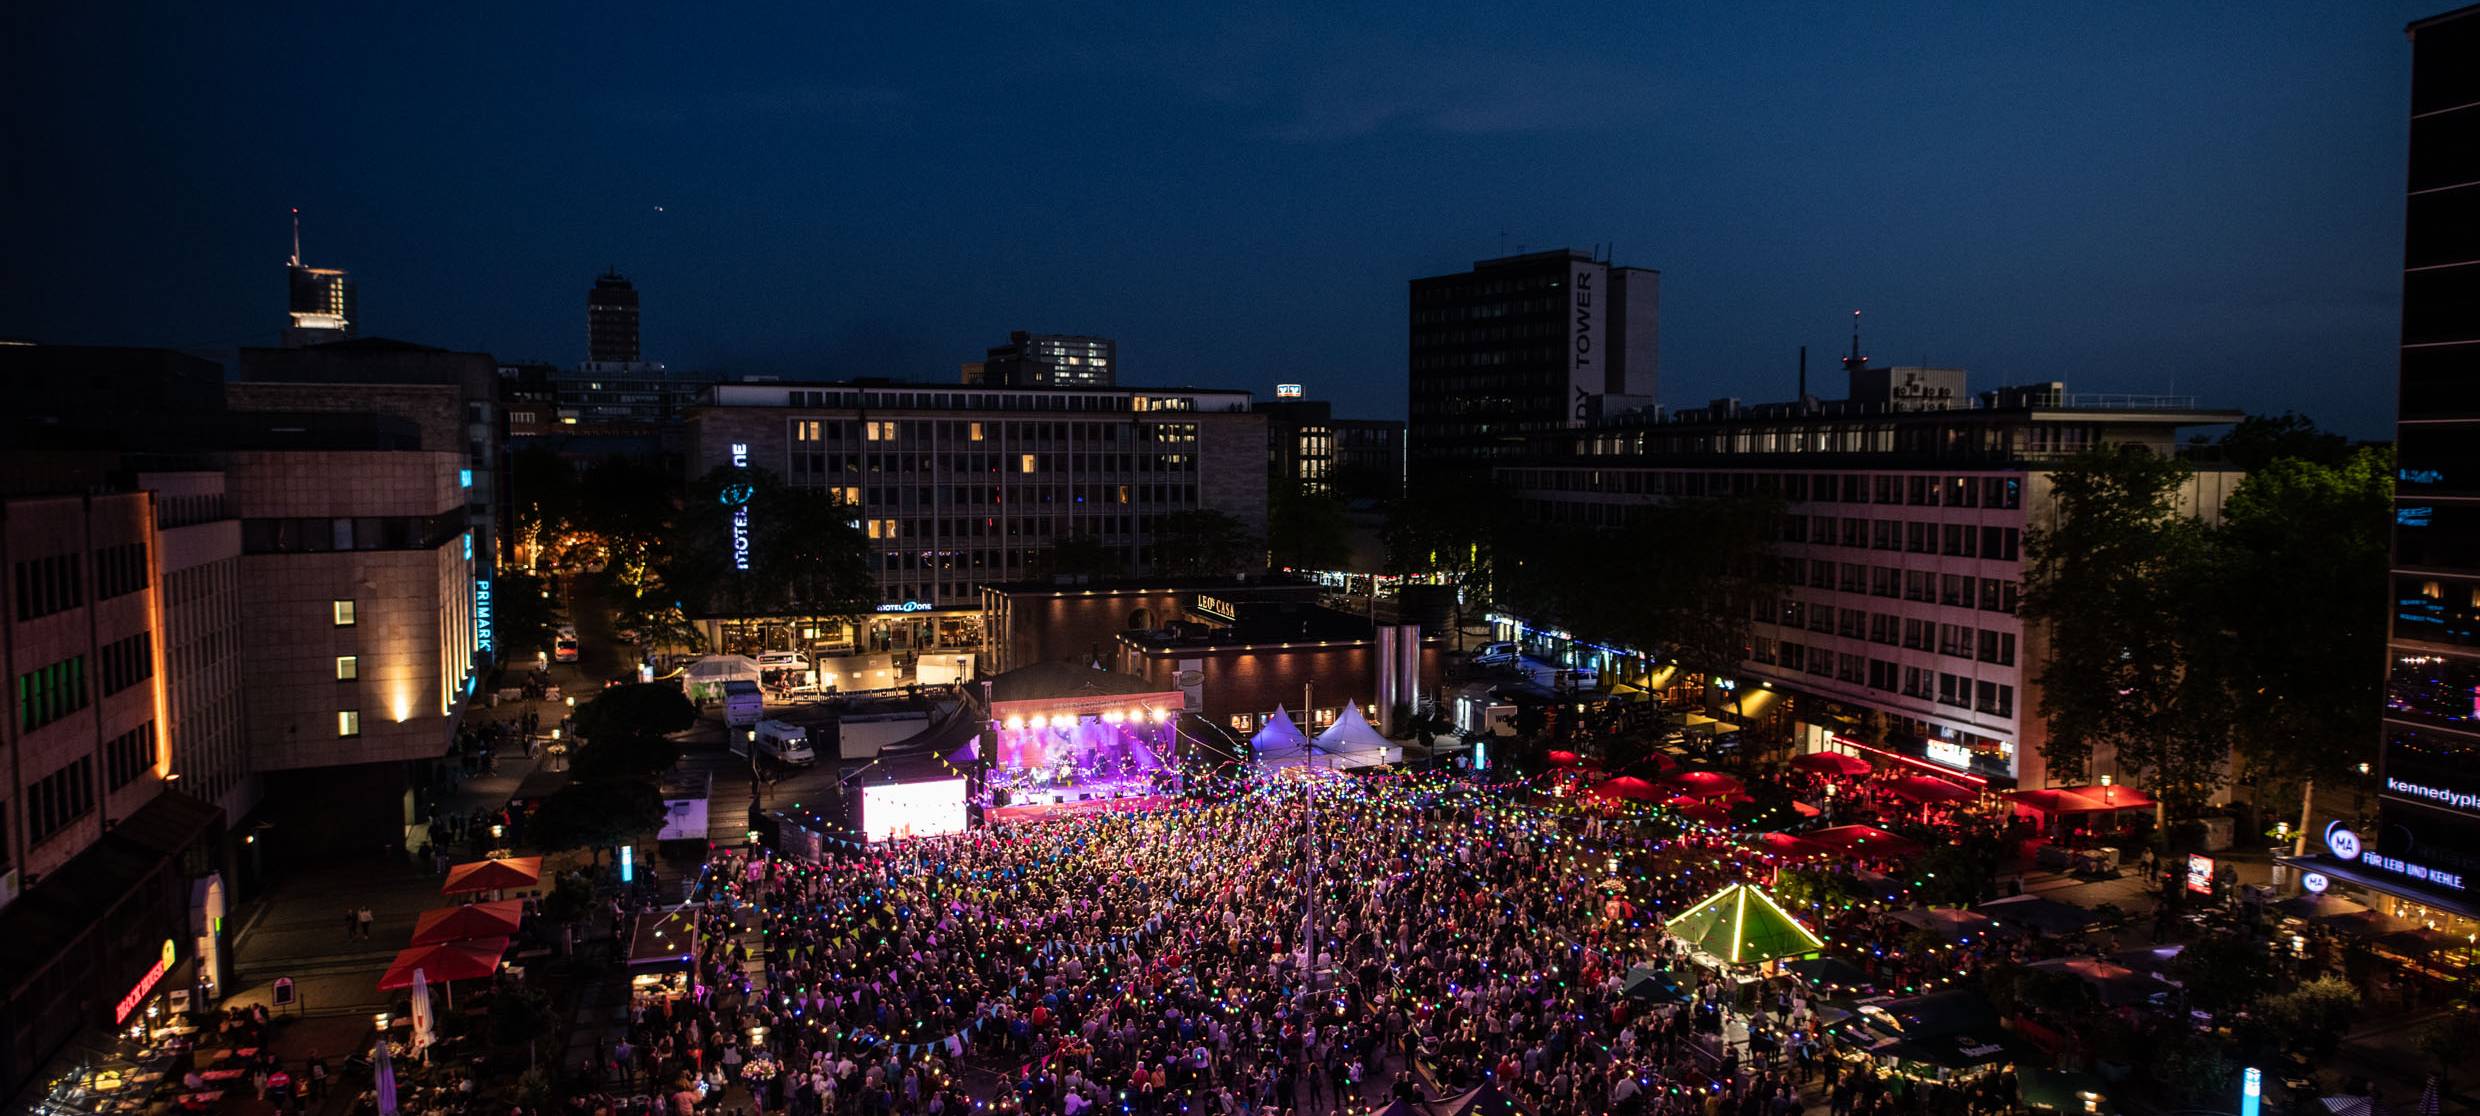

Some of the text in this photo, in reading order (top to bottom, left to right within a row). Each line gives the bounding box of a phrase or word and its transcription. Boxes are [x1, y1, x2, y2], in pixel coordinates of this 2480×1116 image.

[1576, 272, 1592, 422] DY TOWER
[732, 443, 748, 468] NE
[476, 580, 492, 652] PRIMARK
[916, 602, 933, 611] ONE
[1215, 599, 1236, 618] CASA
[2335, 835, 2354, 853] MA
[2362, 851, 2383, 866] FÜR
[2383, 857, 2406, 874] LEIB
[2405, 863, 2428, 879] UND
[2308, 876, 2324, 888] MA
